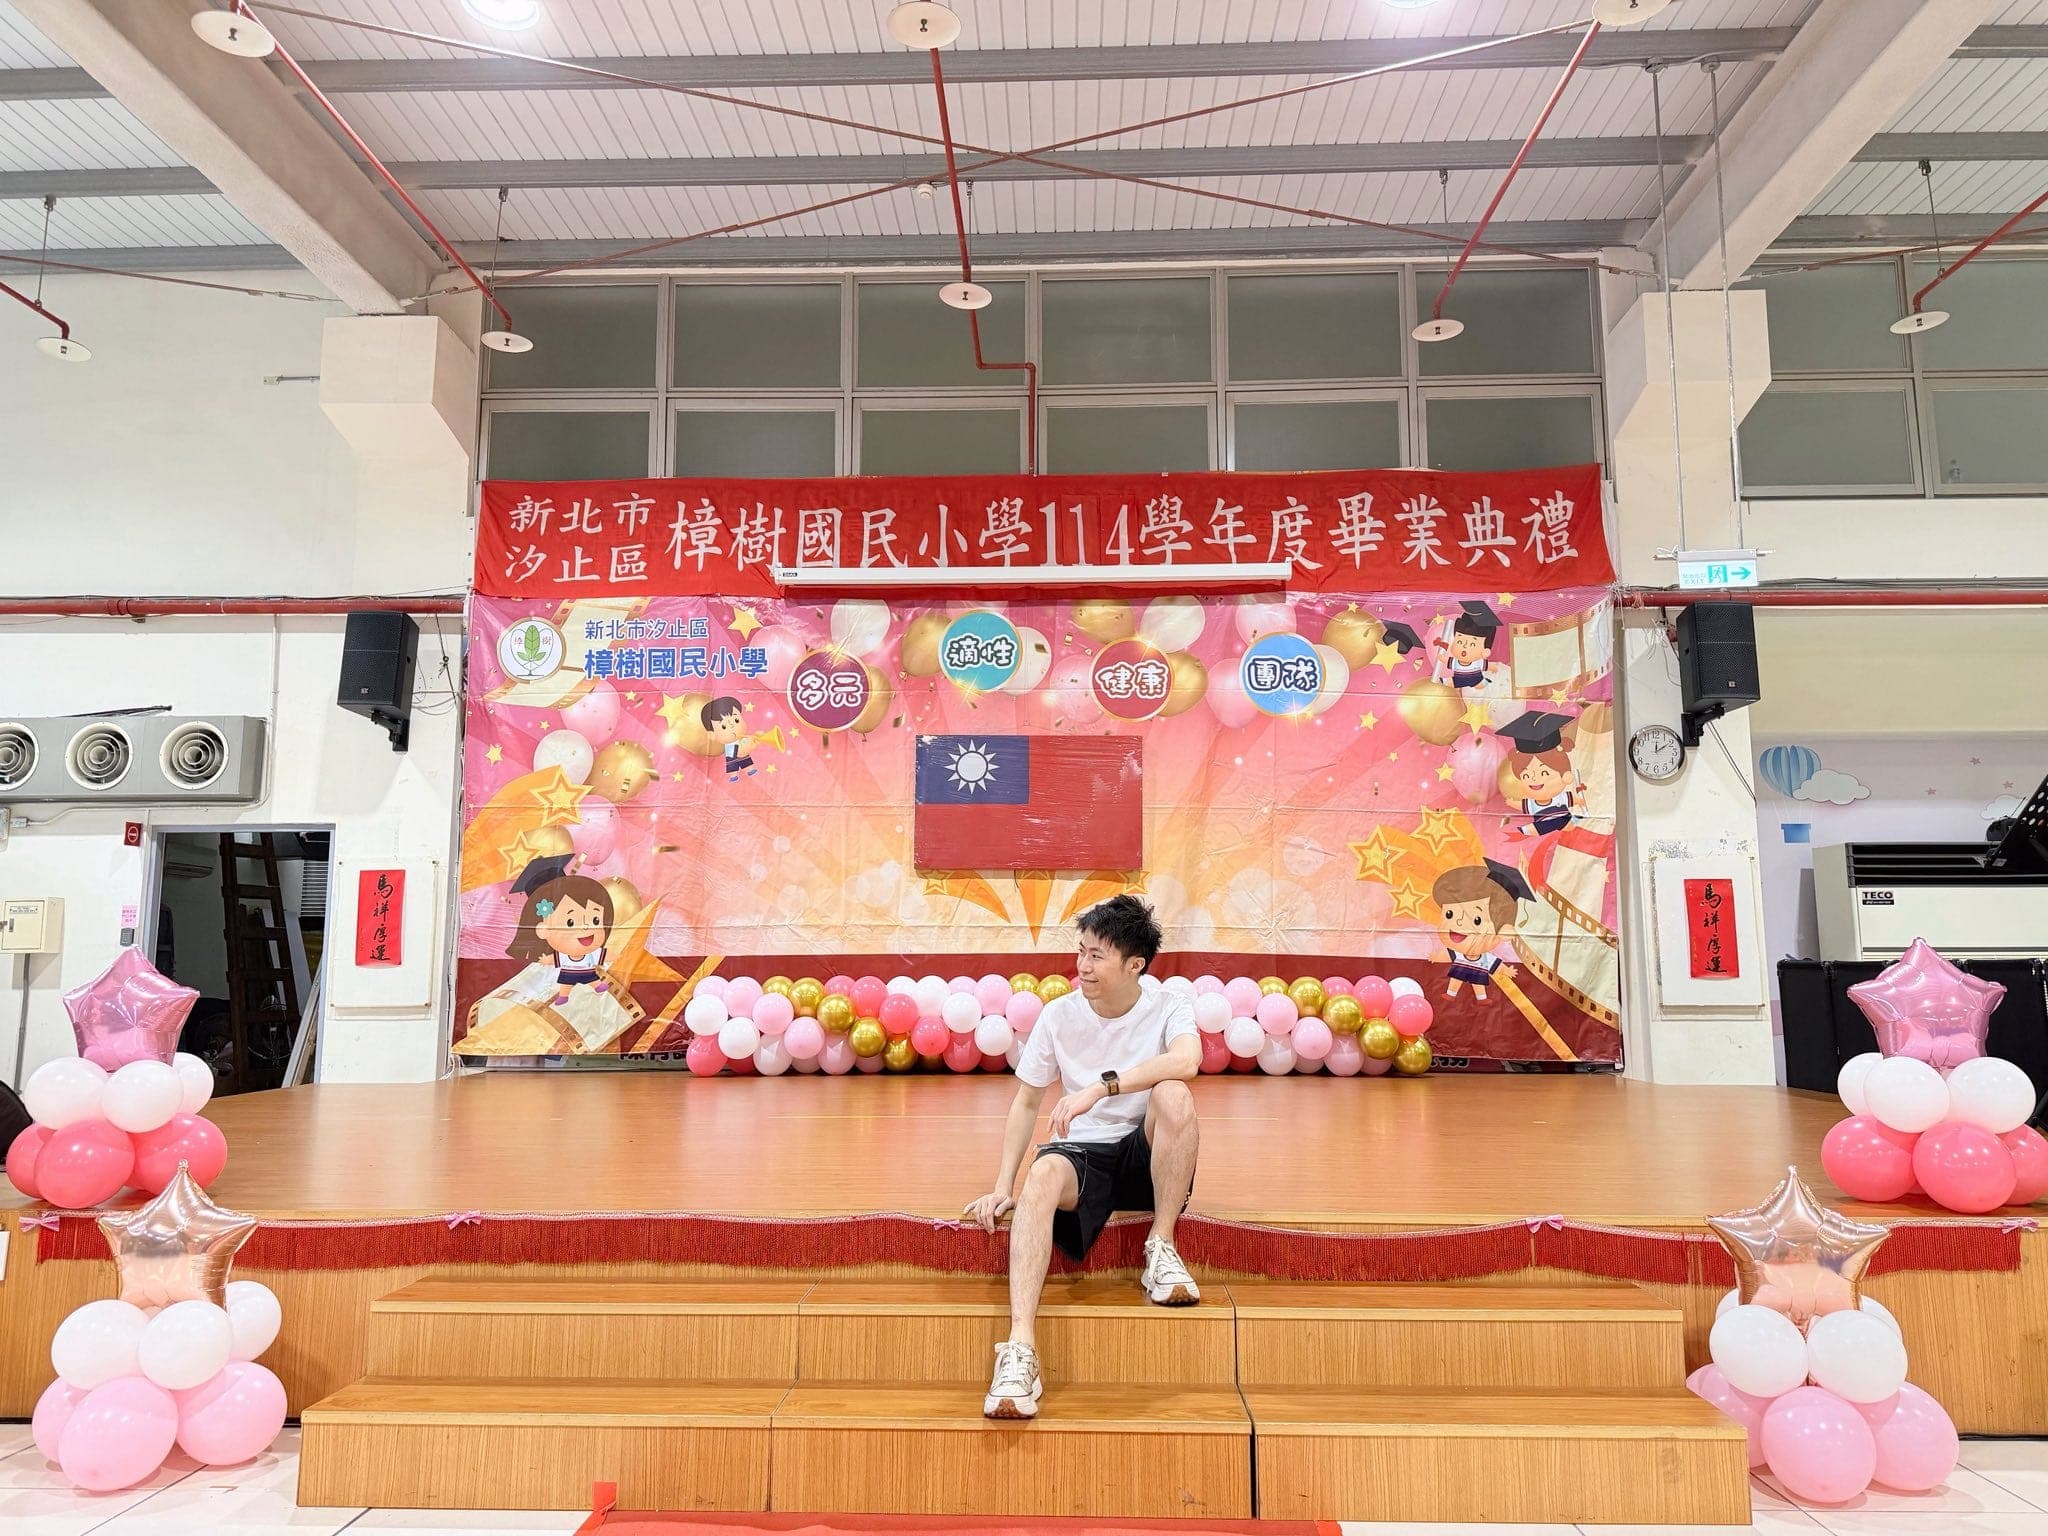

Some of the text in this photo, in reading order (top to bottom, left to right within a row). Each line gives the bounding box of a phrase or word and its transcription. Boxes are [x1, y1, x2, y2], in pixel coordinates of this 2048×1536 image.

[508, 492, 657, 537] 新北市
[664, 489, 1579, 572] 樟樹國民小學114學年度畢業典禮
[504, 543, 650, 584] 汐止區
[584, 618, 709, 640] 新北市汐止區
[583, 646, 769, 680] 樟樹國民小學
[946, 635, 1016, 668] 適性
[797, 669, 864, 710] 多元
[1096, 661, 1169, 699] 健康
[1247, 655, 1320, 692] 團隊
[1862, 891, 1893, 899] TECO
